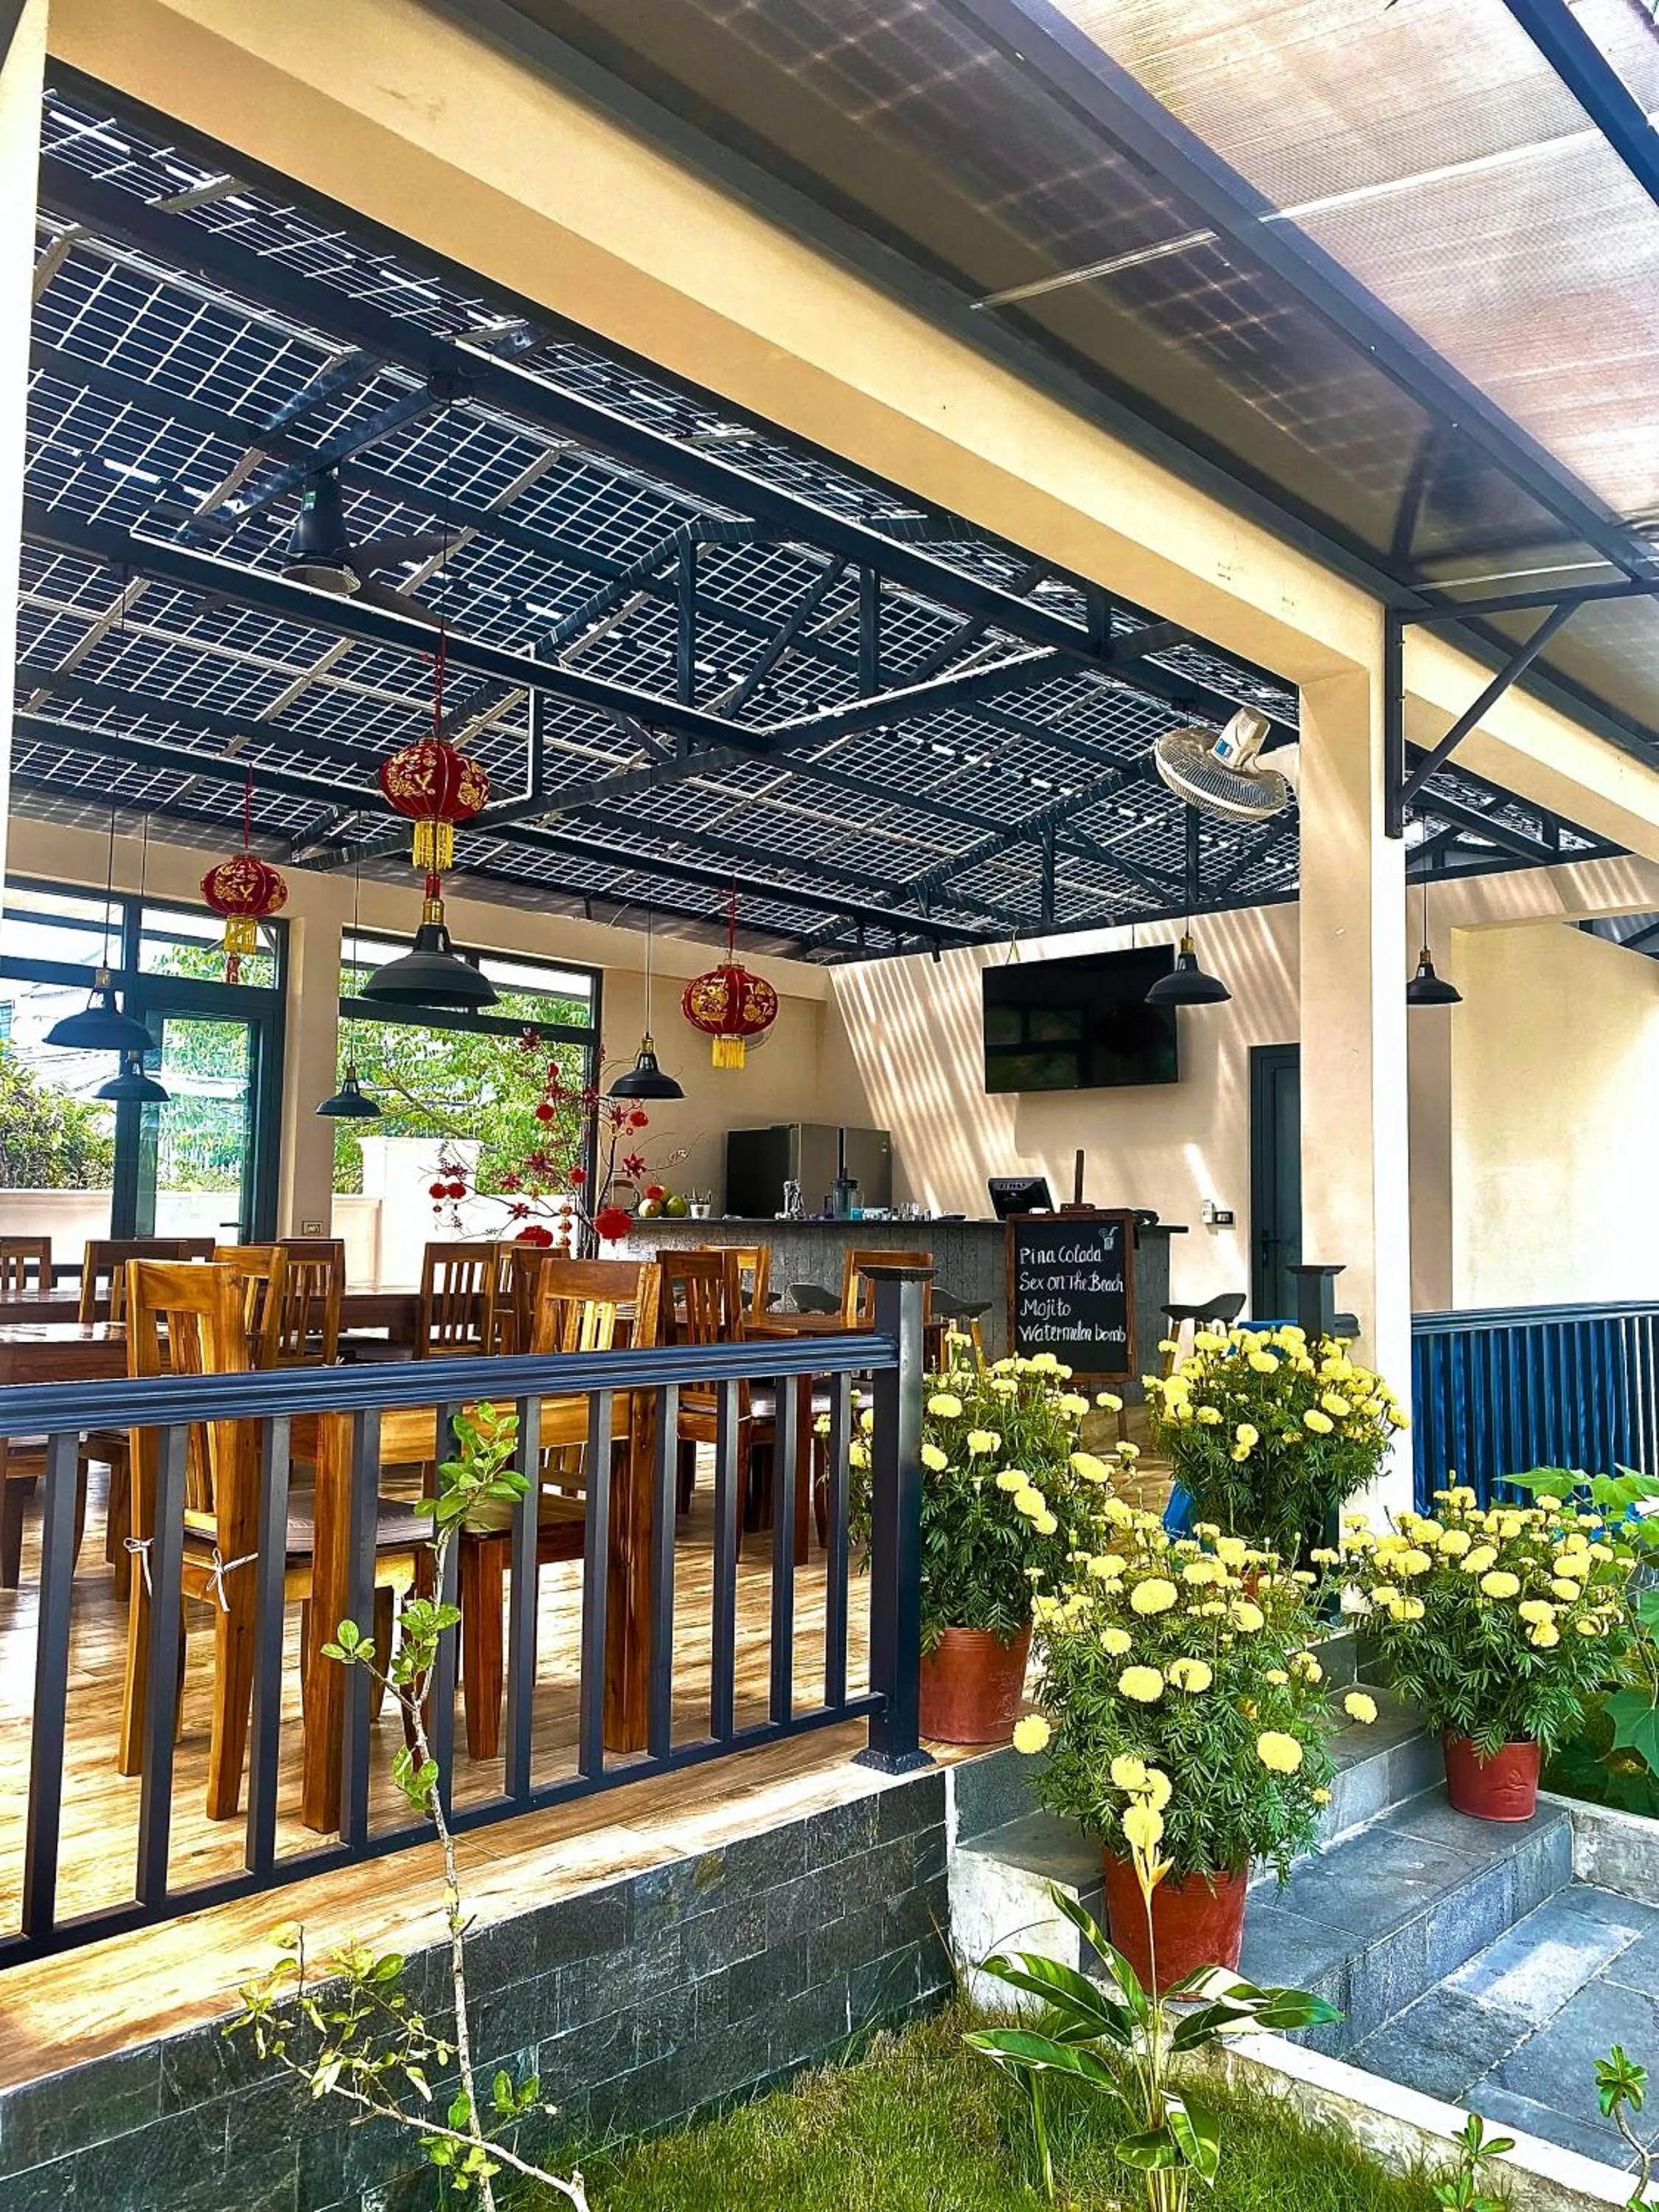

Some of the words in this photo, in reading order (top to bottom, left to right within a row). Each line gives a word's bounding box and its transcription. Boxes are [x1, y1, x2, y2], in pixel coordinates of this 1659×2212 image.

[1020, 1248, 1057, 1265] Pina
[1058, 1243, 1104, 1263] Colada
[1020, 1272, 1044, 1290] Sex
[1066, 1269, 1088, 1290] The
[1088, 1270, 1124, 1292] Beach
[1020, 1298, 1071, 1321] Mojito
[1018, 1319, 1092, 1342] Watermelon
[1095, 1324, 1126, 1343] bomb
